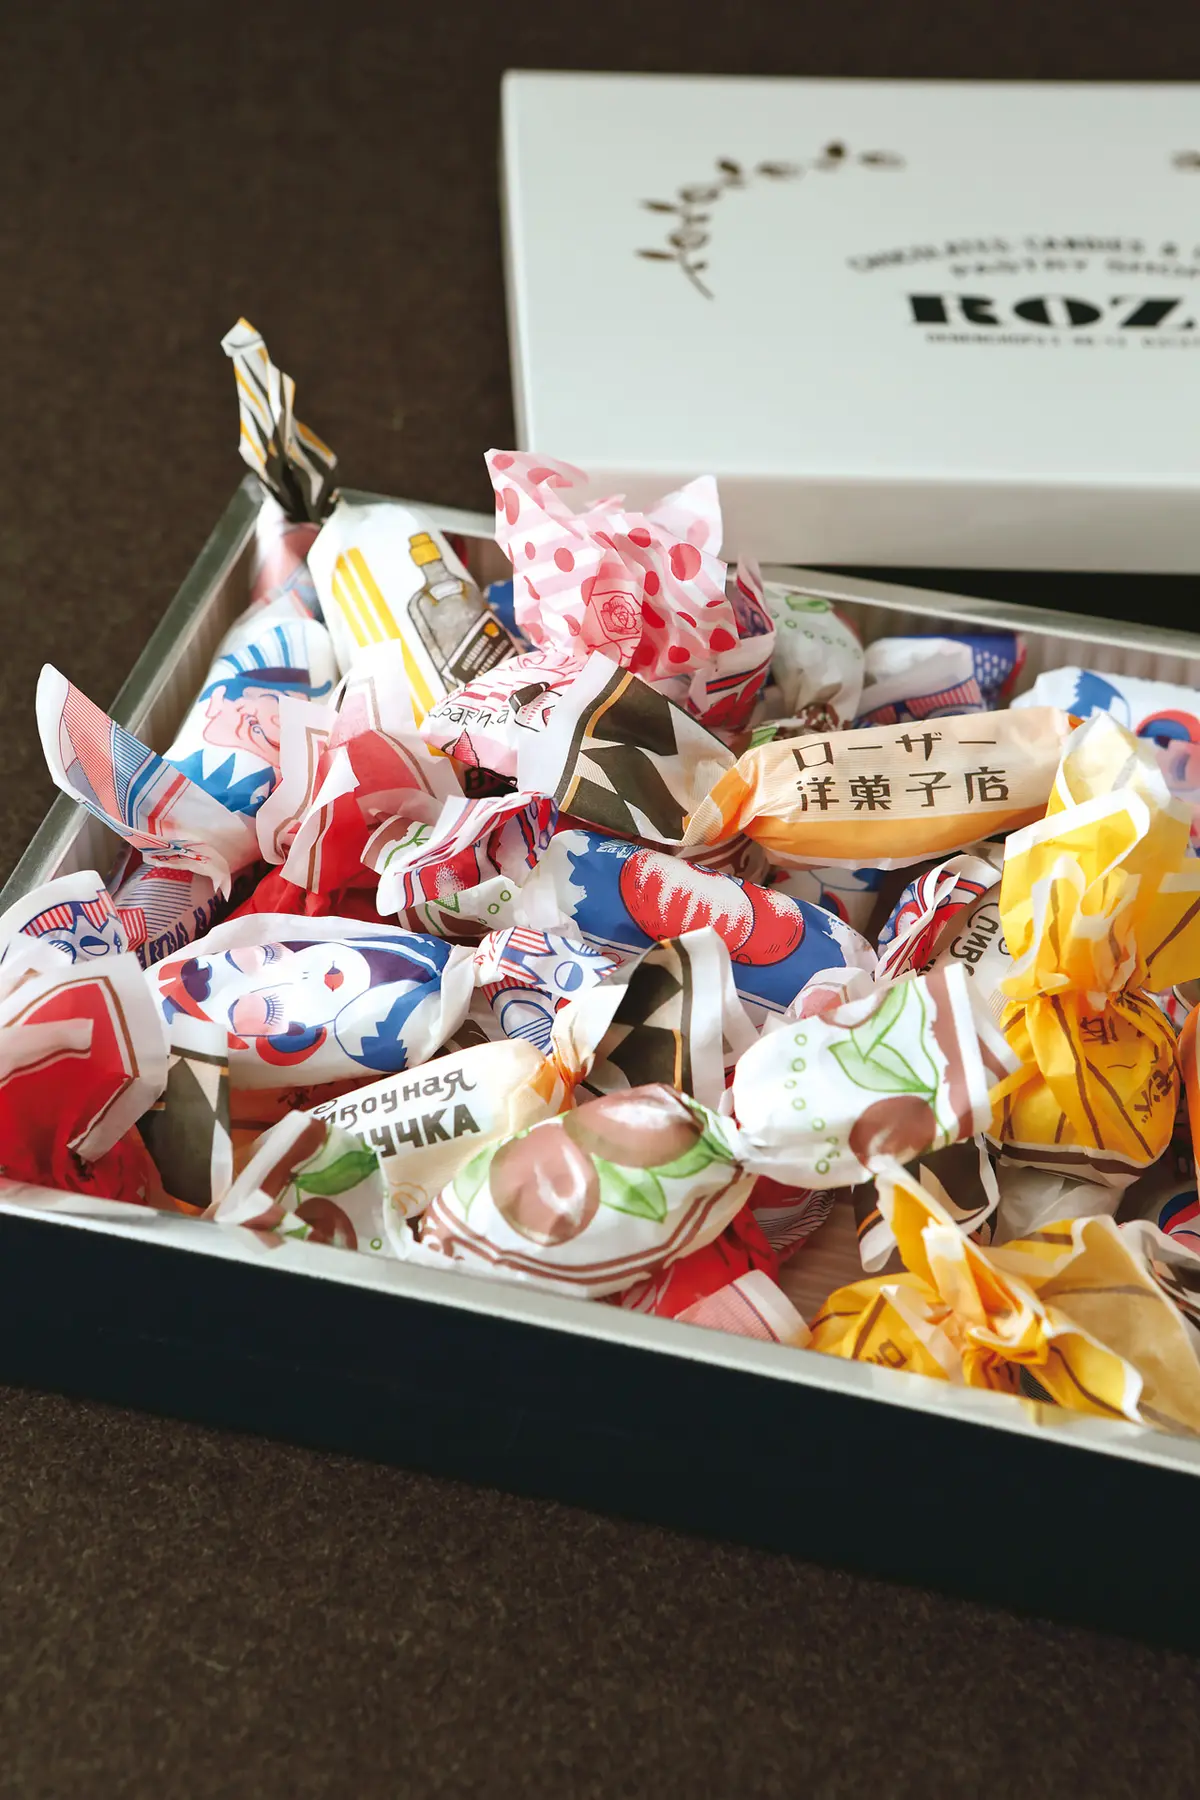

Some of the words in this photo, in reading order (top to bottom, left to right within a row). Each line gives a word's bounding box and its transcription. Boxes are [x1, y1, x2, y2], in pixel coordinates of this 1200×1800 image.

[792, 732, 997, 771] ローザー
[796, 766, 1009, 811] 洋菓子店
